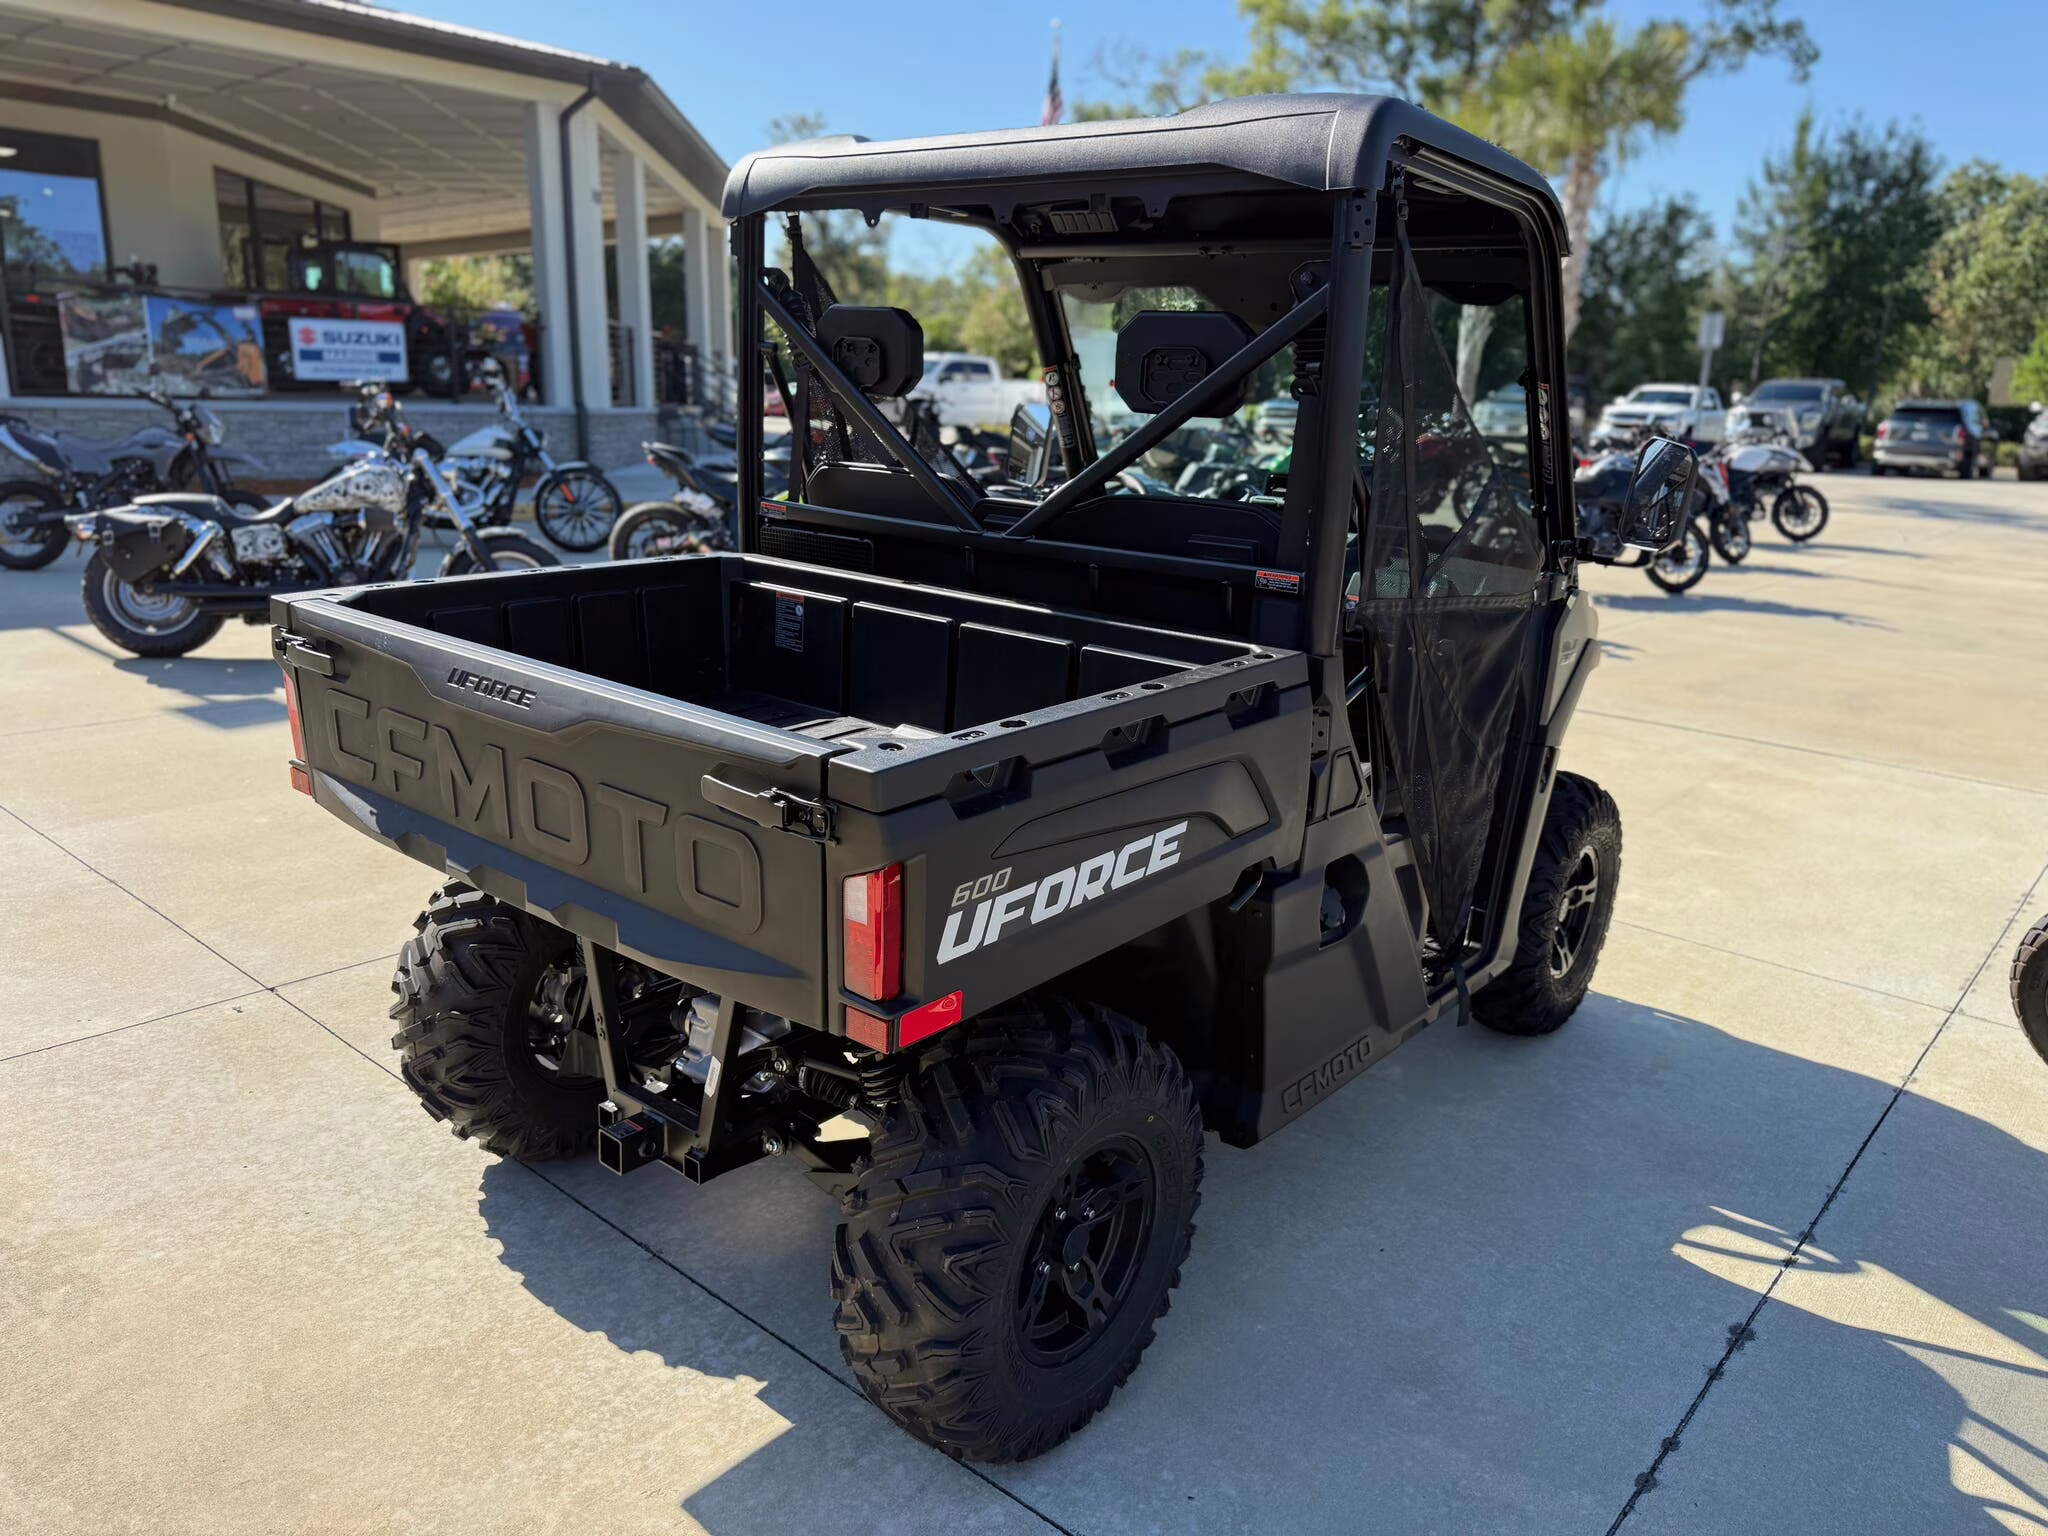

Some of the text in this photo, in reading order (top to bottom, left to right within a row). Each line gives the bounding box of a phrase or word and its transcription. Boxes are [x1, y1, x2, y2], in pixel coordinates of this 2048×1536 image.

[323, 331, 400, 346] SUZUKI
[447, 666, 537, 710] UFORCE
[326, 688, 763, 935] CFMOTO
[936, 820, 1188, 966] UFORCE
[951, 866, 1013, 908] 600
[1281, 1034, 1371, 1114] CFMOTO
